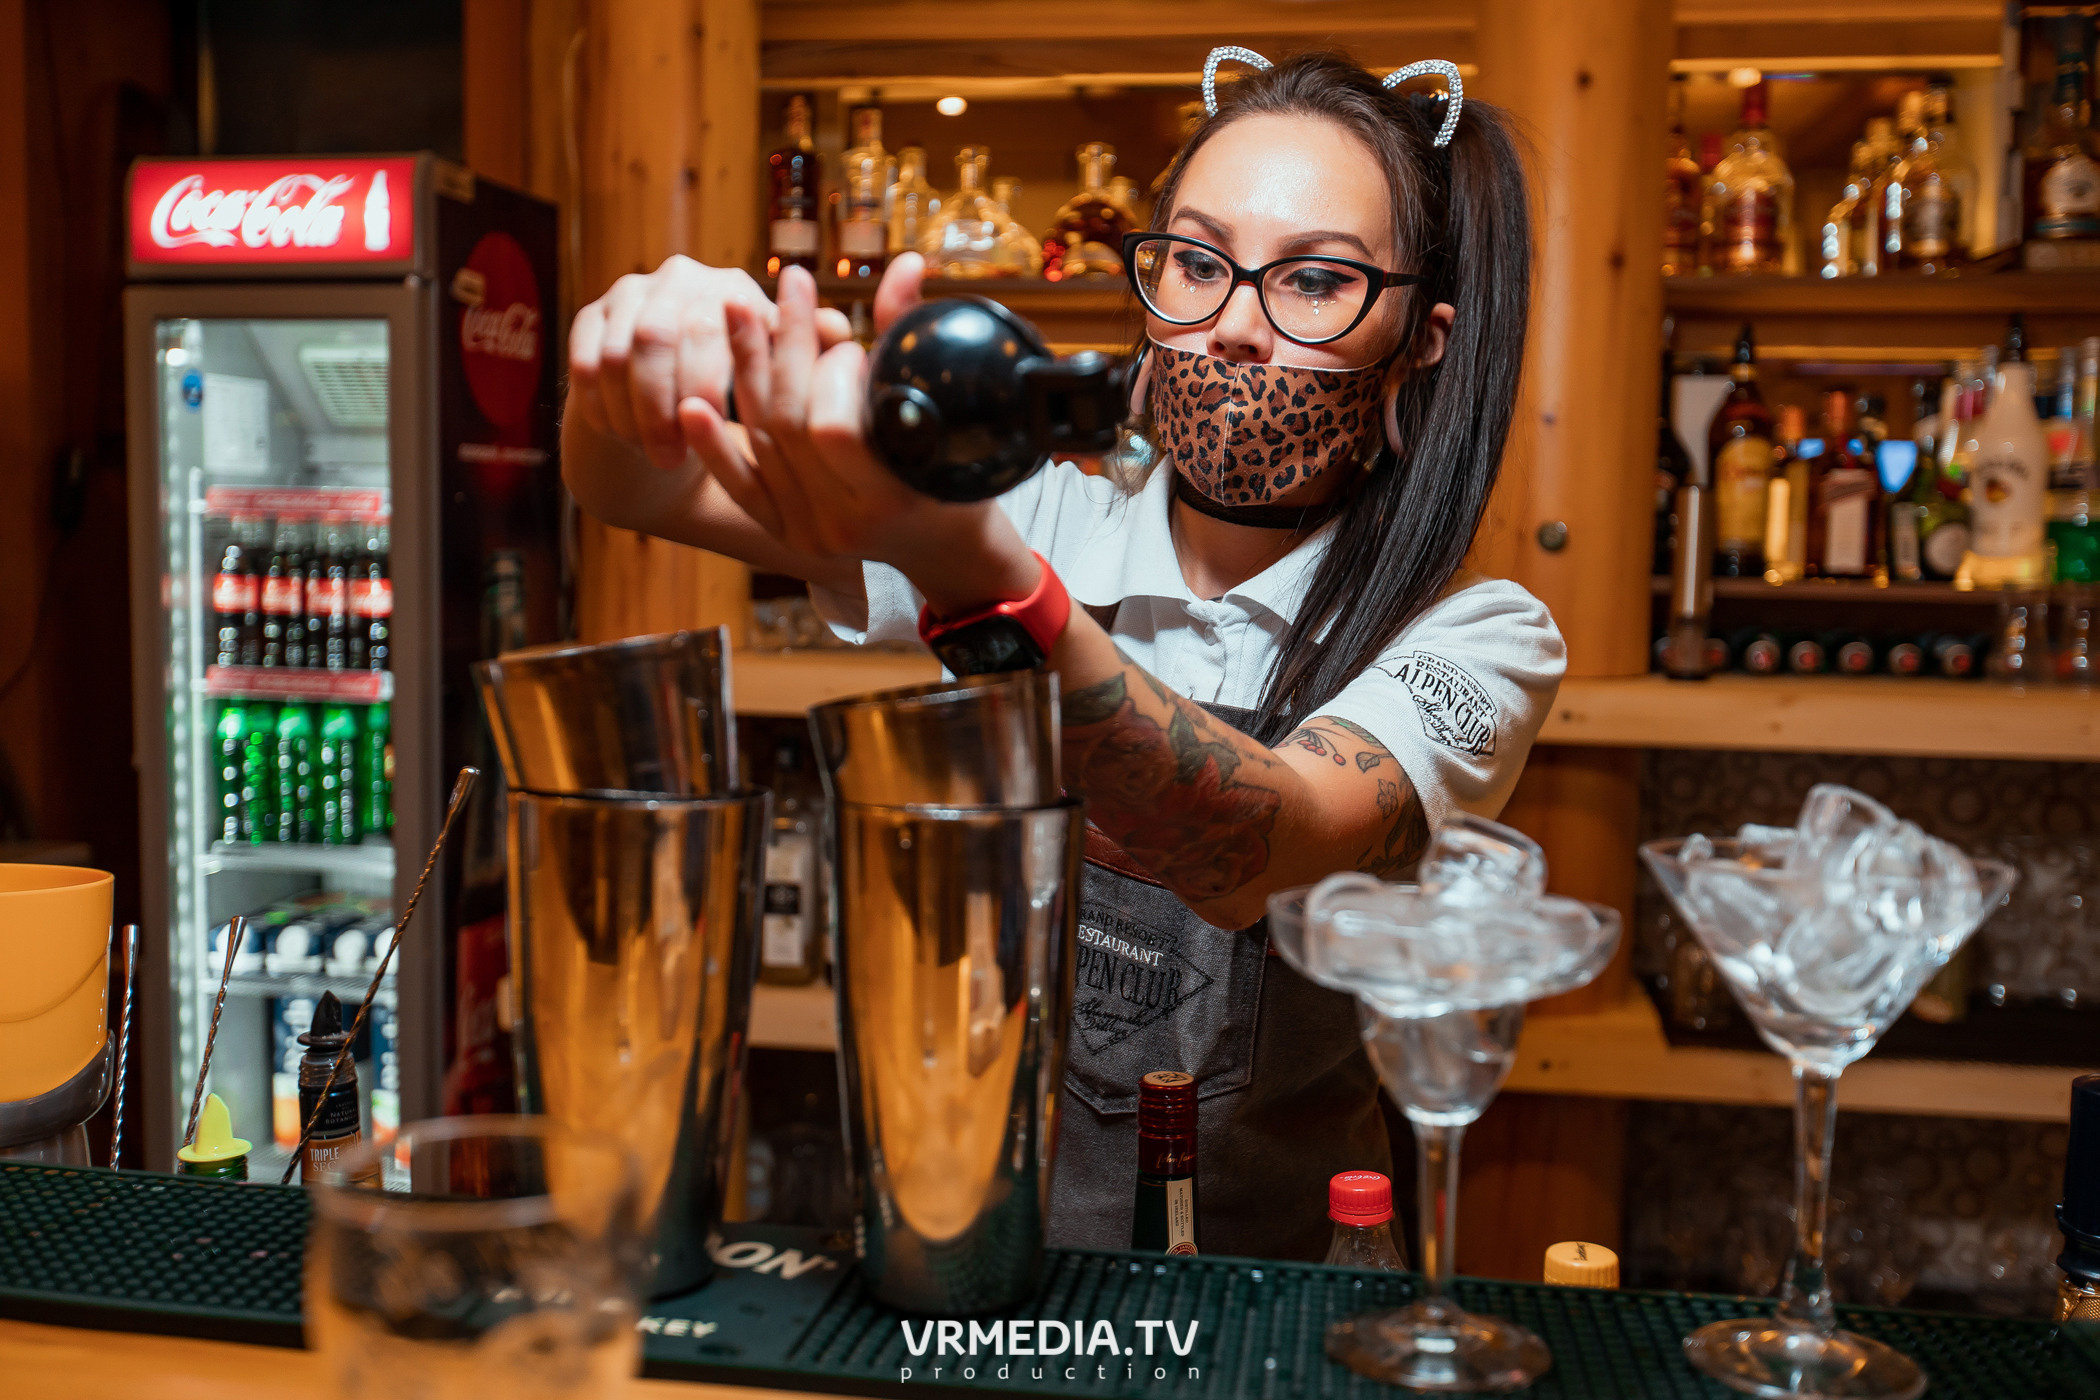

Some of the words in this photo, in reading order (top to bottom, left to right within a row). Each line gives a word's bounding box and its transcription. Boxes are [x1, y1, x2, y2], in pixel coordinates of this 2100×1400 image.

[1417, 654, 1459, 676] GRAND
[1416, 659, 1488, 719] RESTAURANT
[1393, 663, 1460, 711] ALPEN
[1455, 701, 1491, 756] CLUB
[1080, 907, 1113, 929] RAND
[1077, 923, 1164, 967] ESTAURANT
[1076, 945, 1119, 995] PEN
[1120, 963, 1183, 1009] CLUB
[309, 1146, 340, 1162] TRIPLE
[312, 1160, 337, 1172] SEC
